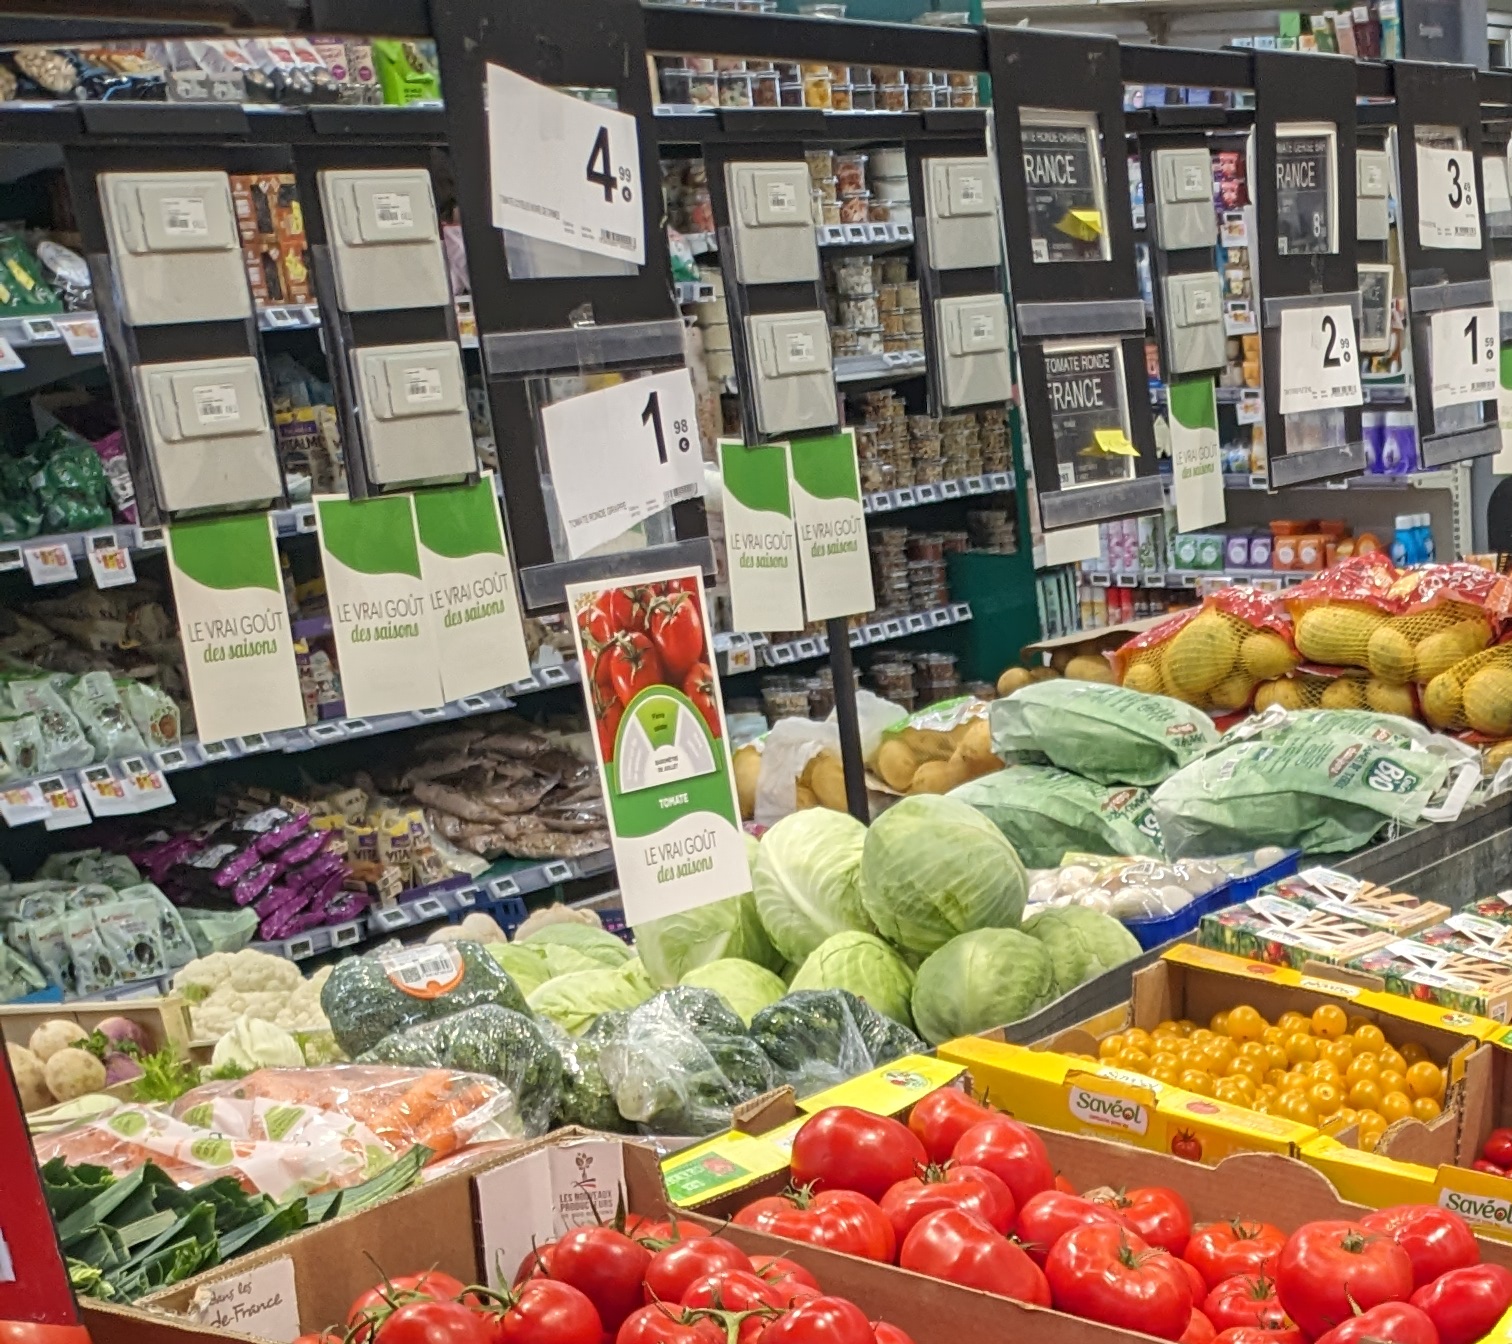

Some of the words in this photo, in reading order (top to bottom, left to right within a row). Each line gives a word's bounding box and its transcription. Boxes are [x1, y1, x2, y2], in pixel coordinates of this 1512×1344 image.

[586, 125, 618, 203] 4
[619, 166, 632, 182] 99
[1023, 153, 1077, 184] RANCE
[1276, 162, 1315, 188] RANCE
[1447, 158, 1463, 210] 3
[1322, 315, 1341, 369] 2
[1464, 315, 1478, 366] 1
[1044, 356, 1080, 374] TOMATE
[1081, 353, 1110, 370] RONDE
[641, 391, 668, 464] 1
[674, 419, 688, 434] 98
[730, 533, 740, 550] LE
[742, 534, 763, 549] VRAI
[764, 531, 792, 550] GOÛT
[801, 525, 812, 541] LE
[813, 521, 833, 539] VRAI
[740, 552, 754, 568] des
[756, 552, 788, 568] saisons
[811, 542, 825, 558] des
[826, 538, 857, 555] saisons
[431, 592, 444, 611] LE
[444, 584, 472, 606] VRAI
[475, 571, 509, 599] GOÛT
[337, 605, 352, 623] LE
[353, 601, 383, 621] VRAI
[386, 593, 424, 617] GOÛT
[444, 609, 463, 628] des
[464, 599, 505, 622] saisons
[188, 621, 205, 643] LE
[205, 618, 238, 640] VRAI
[240, 608, 283, 634] GOÛT
[351, 624, 371, 644] des
[374, 621, 419, 641] saisons
[204, 642, 226, 664] des
[228, 638, 277, 660] saisons
[658, 792, 689, 809] TOMATE
[644, 846, 658, 866] LE
[658, 839, 683, 860] VRAI
[684, 828, 716, 855] GOÛT
[657, 864, 675, 884] des
[676, 855, 713, 880] saisons
[1076, 1092, 1142, 1124] Savéol
[560, 1193, 573, 1203] LES
[237, 1280, 253, 1296] les
